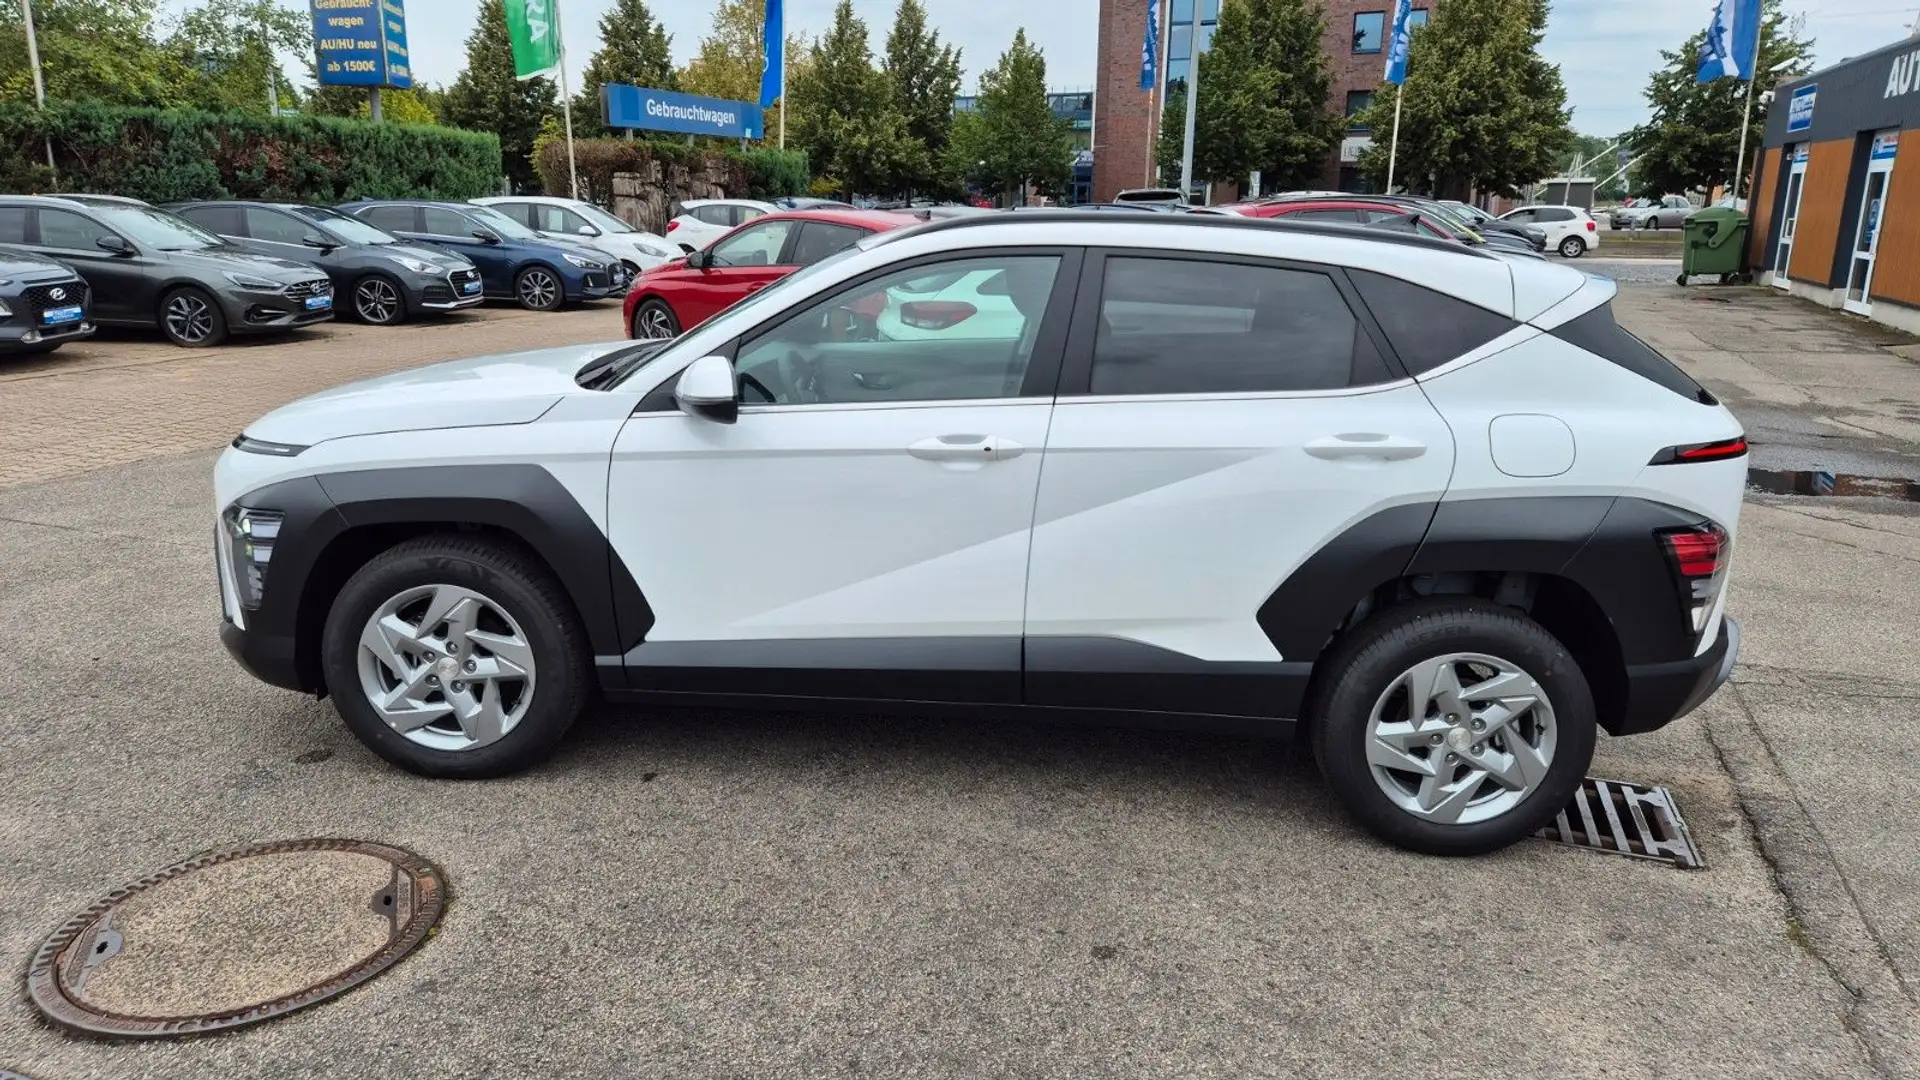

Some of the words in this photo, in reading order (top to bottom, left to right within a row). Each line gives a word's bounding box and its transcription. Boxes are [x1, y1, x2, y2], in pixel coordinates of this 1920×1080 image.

[328, 16, 364, 28] wagen
[357, 40, 378, 49] neu
[327, 61, 341, 72] ab
[343, 60, 376, 72] 1500€
[646, 99, 735, 127] Gebrauchtwagen
